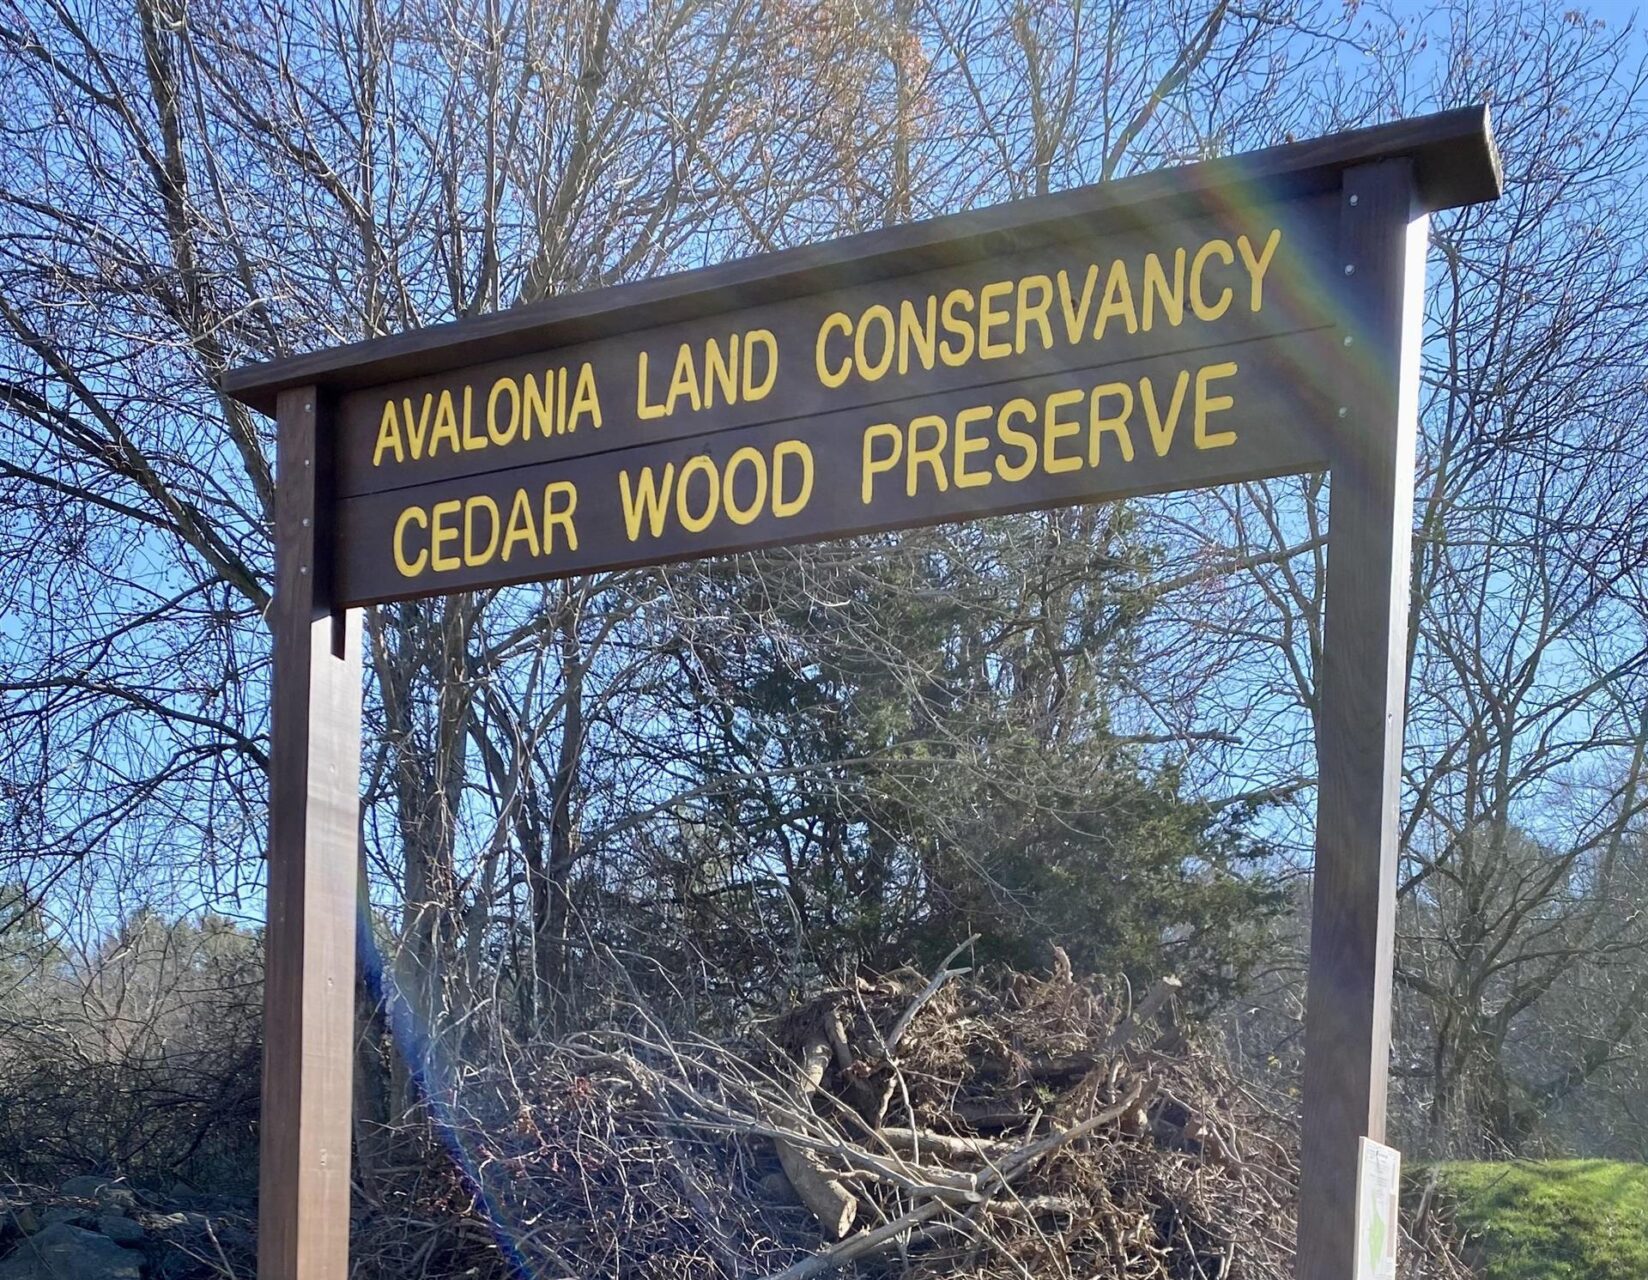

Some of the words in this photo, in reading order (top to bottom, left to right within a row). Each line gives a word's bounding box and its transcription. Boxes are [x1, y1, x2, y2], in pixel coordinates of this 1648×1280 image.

[373, 361, 602, 466] AVALONIA
[637, 329, 777, 419] LAND
[815, 229, 1282, 388] CONSERVANCY
[393, 481, 578, 578] CEDAR
[620, 440, 815, 541] WOOD
[861, 363, 1238, 504] PRESERVE
